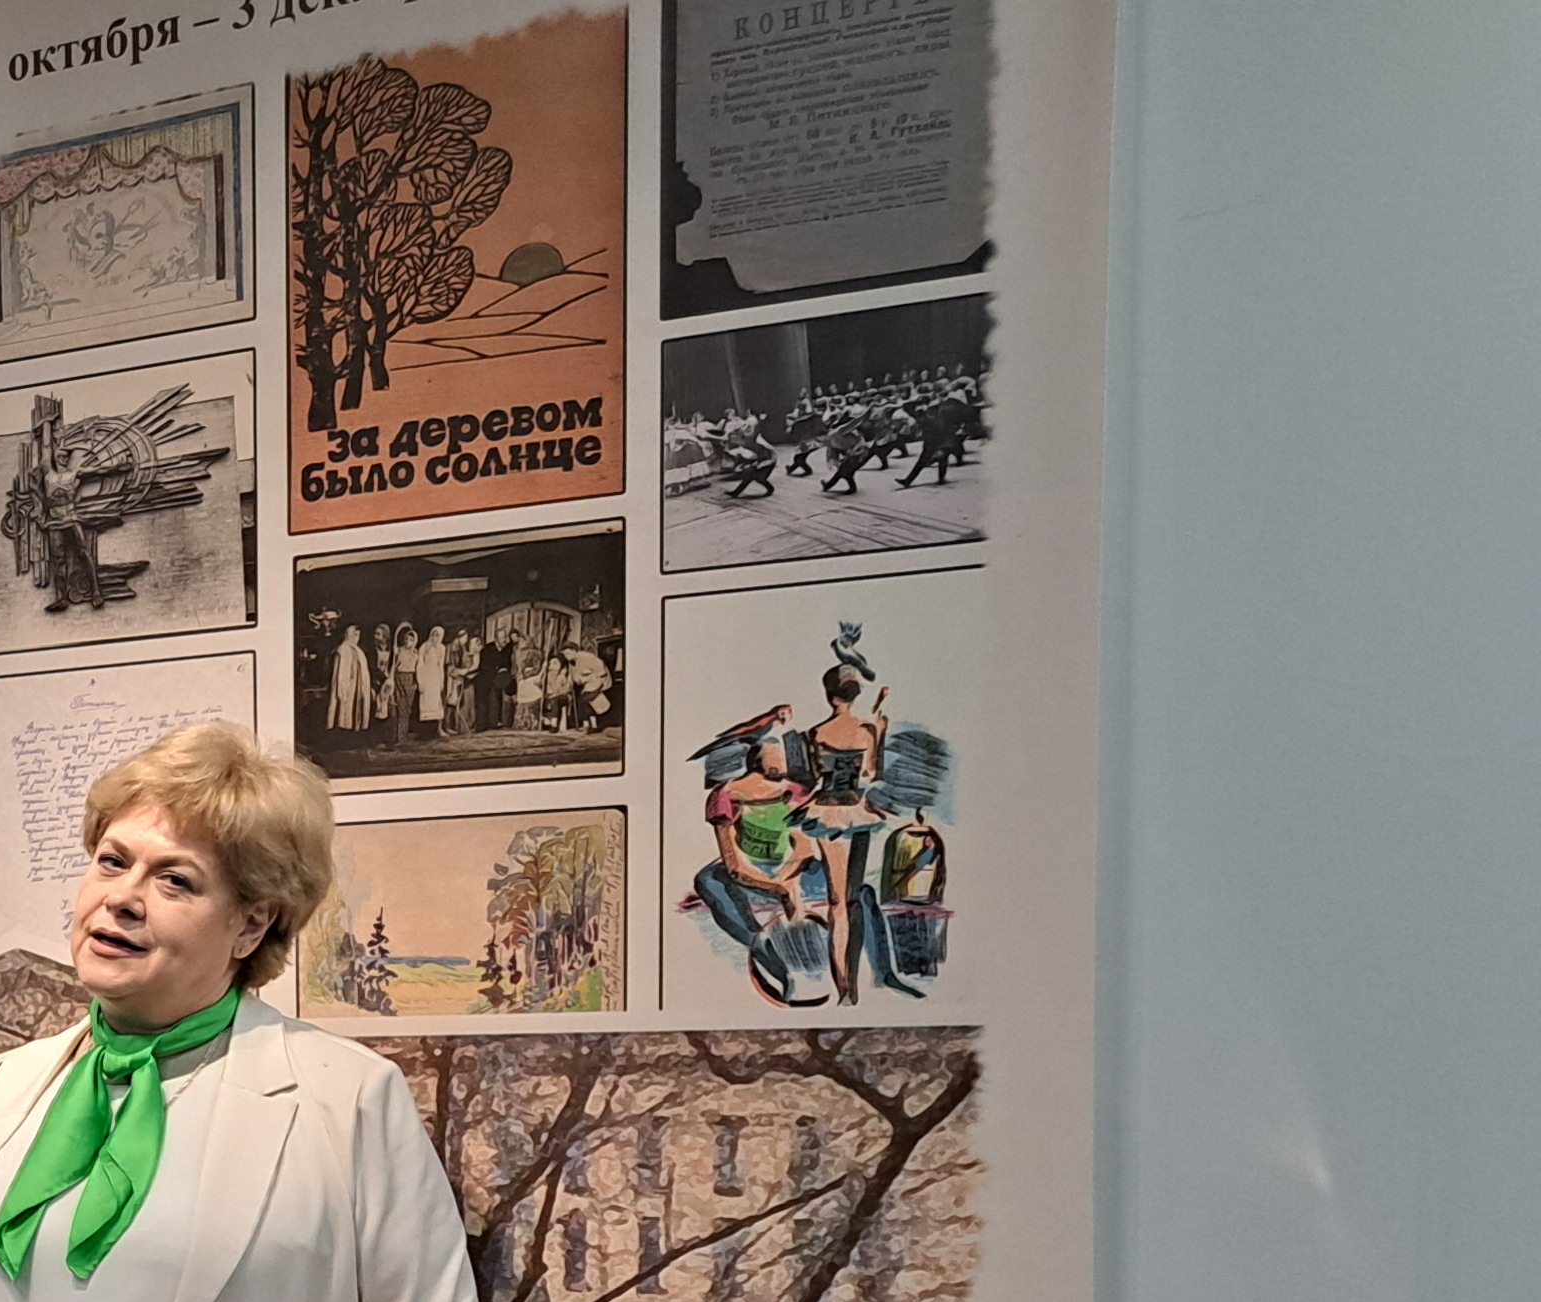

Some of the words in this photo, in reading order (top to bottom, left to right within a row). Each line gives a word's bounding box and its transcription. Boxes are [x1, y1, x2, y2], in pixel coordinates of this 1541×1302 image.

[9, 16, 180, 82] октября
[231, 0, 255, 29] 3
[327, 426, 380, 463] за
[389, 397, 603, 458] деревом
[301, 460, 415, 502] было
[425, 435, 602, 485] солнце
